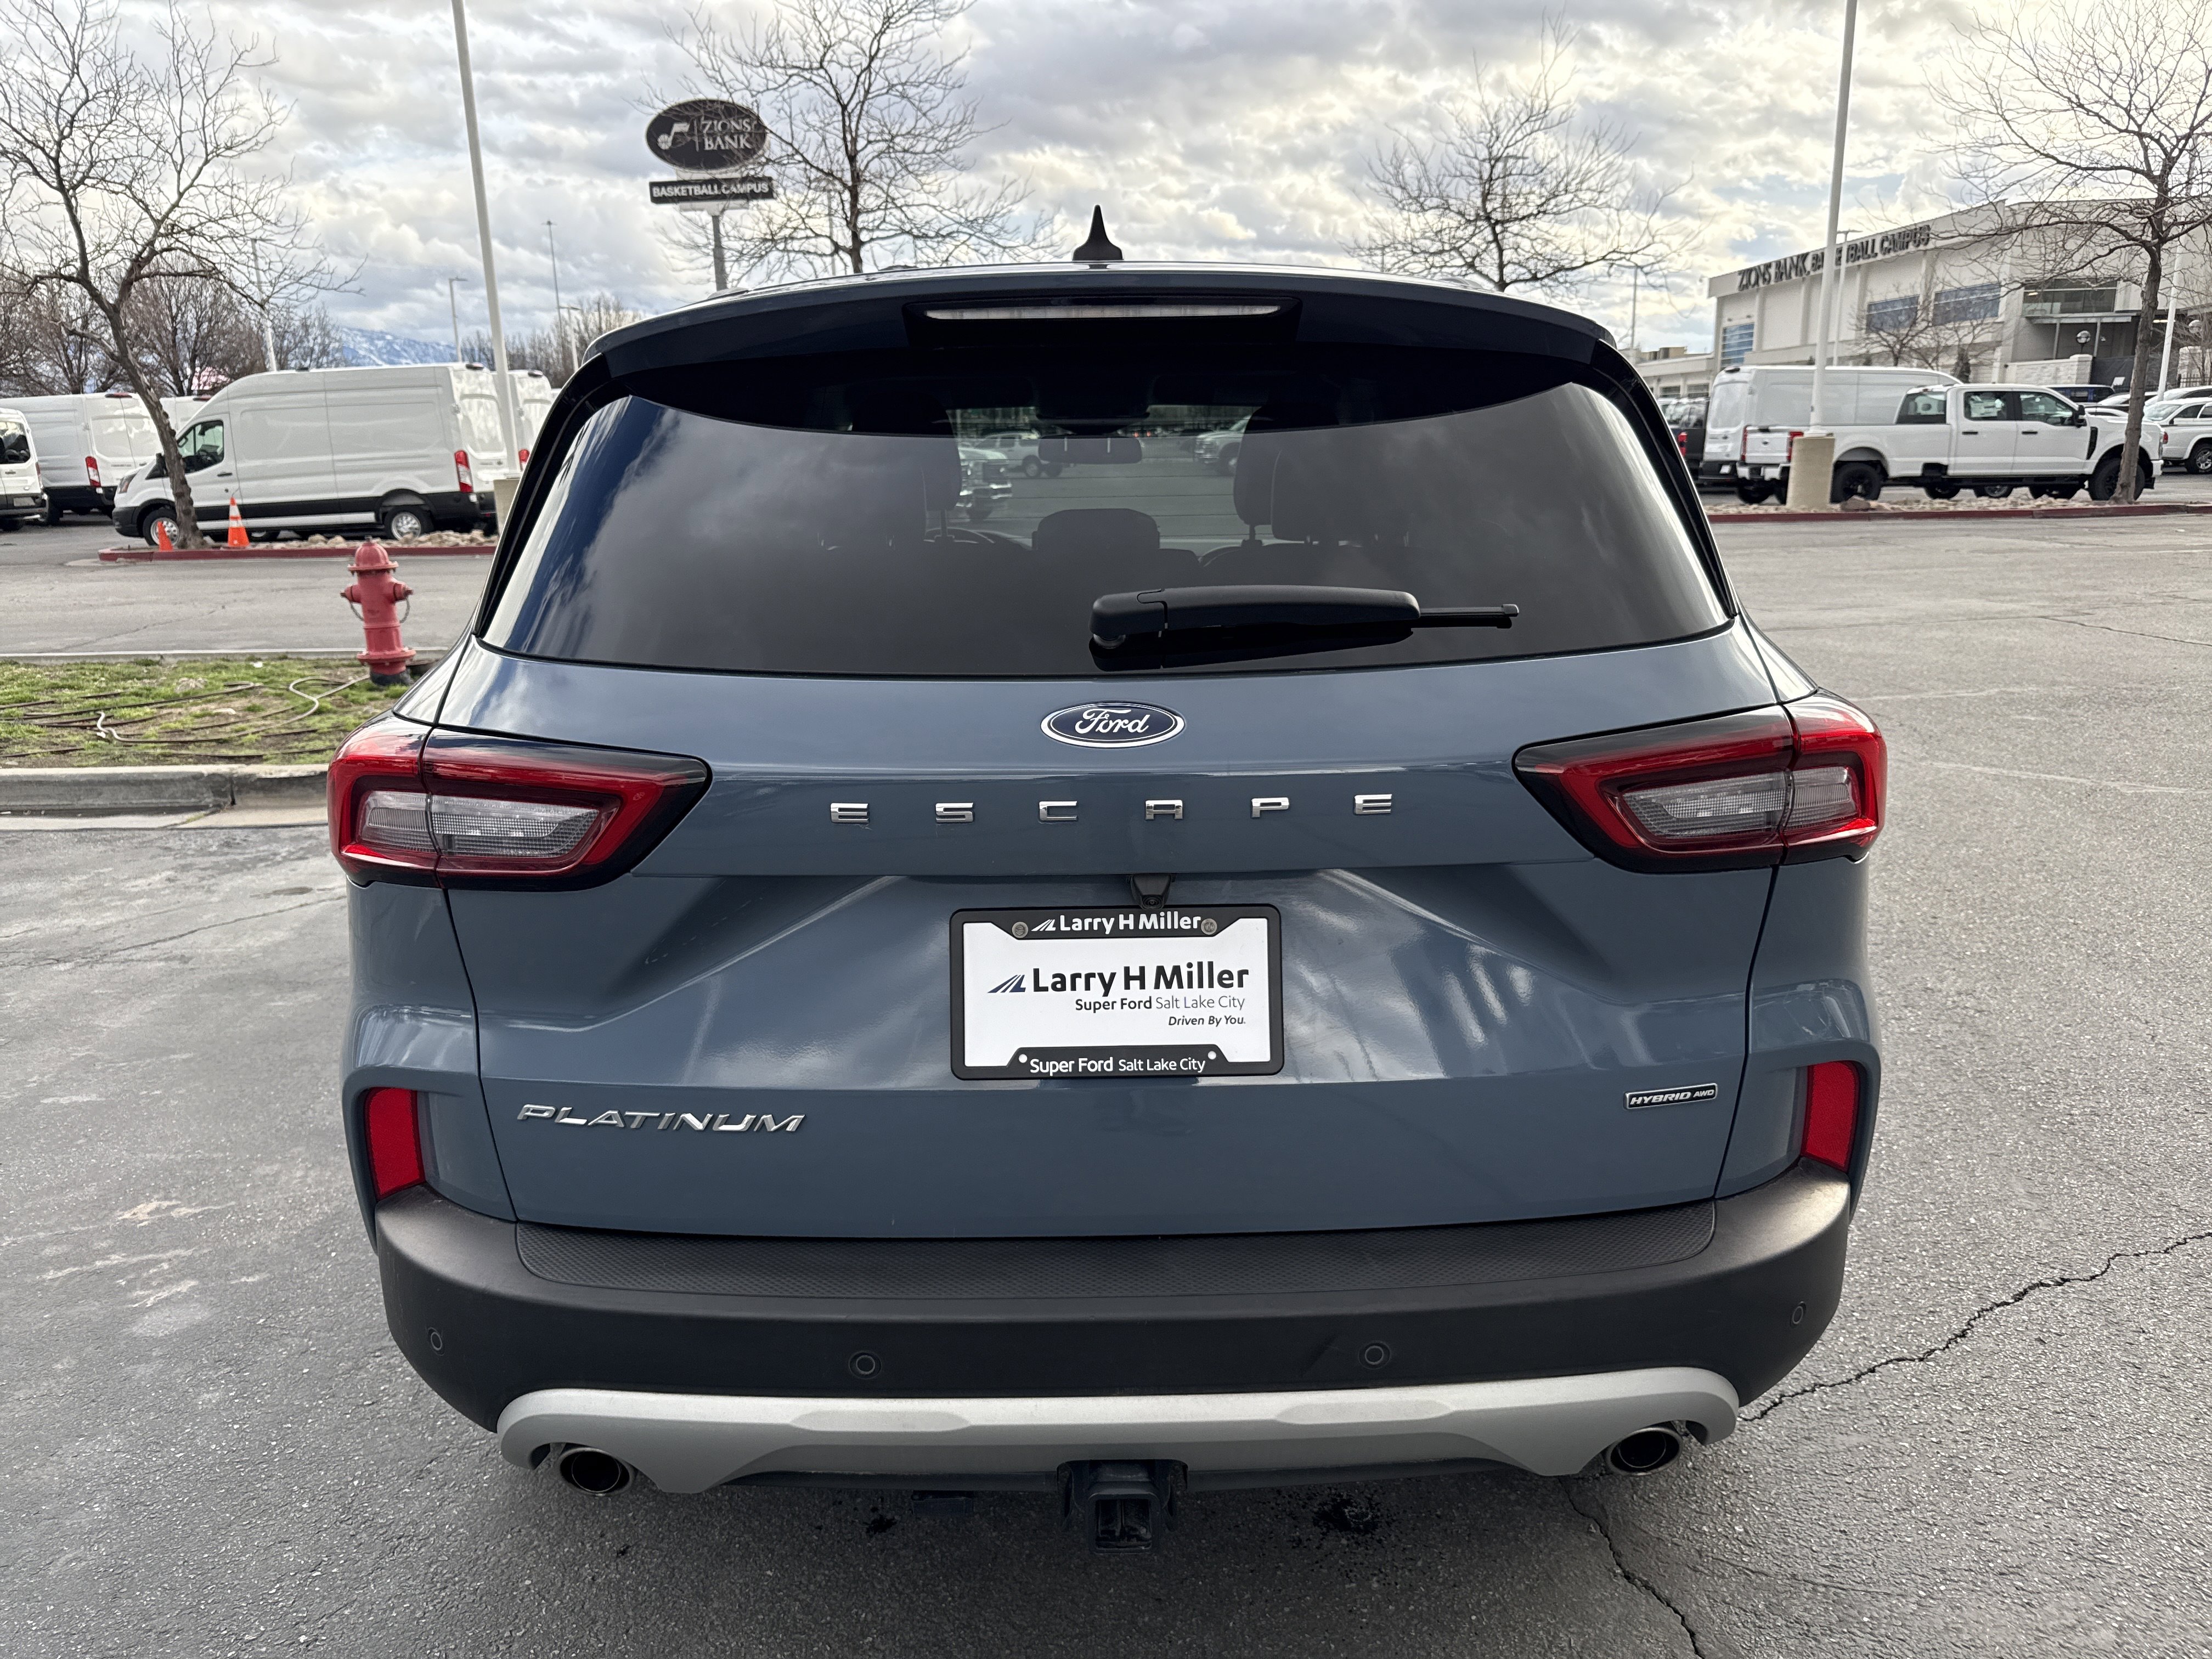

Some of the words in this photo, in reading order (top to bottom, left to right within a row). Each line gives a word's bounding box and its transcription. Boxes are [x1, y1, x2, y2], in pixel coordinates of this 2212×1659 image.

[702, 118, 751, 133] ZIONS
[703, 133, 752, 150] BANK
[652, 184, 721, 198] BASKETBALL
[721, 183, 769, 194] CAMPUS
[1737, 263, 1771, 291] ZIONS
[1811, 239, 1878, 272] BAEBALL
[1879, 224, 1931, 256] CAMPUS
[1074, 708, 1150, 734] Ford
[830, 794, 1392, 823] ESCAPE
[1060, 915, 1115, 935] Larry
[1119, 913, 1134, 930] H
[1138, 911, 1201, 930] Miller
[1032, 968, 1117, 997] Larry
[1123, 966, 1146, 990] H
[1153, 961, 1249, 990] Miller
[1075, 998, 1117, 1014] Super
[1120, 996, 1152, 1010] Ford
[1155, 995, 1180, 1009] Salt
[1184, 995, 1215, 1008] Lake
[1218, 995, 1245, 1011] City
[1168, 1015, 1205, 1026] Driven
[1208, 1015, 1222, 1028] By
[1030, 1058, 1075, 1076] Super
[1078, 1057, 1113, 1072] Ford
[1118, 1058, 1144, 1071] Salt
[1147, 1058, 1177, 1071] Lake
[1180, 1057, 1206, 1073] City
[1630, 1091, 1691, 1105] HYBRID
[1693, 1089, 1715, 1098] AWD
[517, 1103, 806, 1132] PLATINUM
